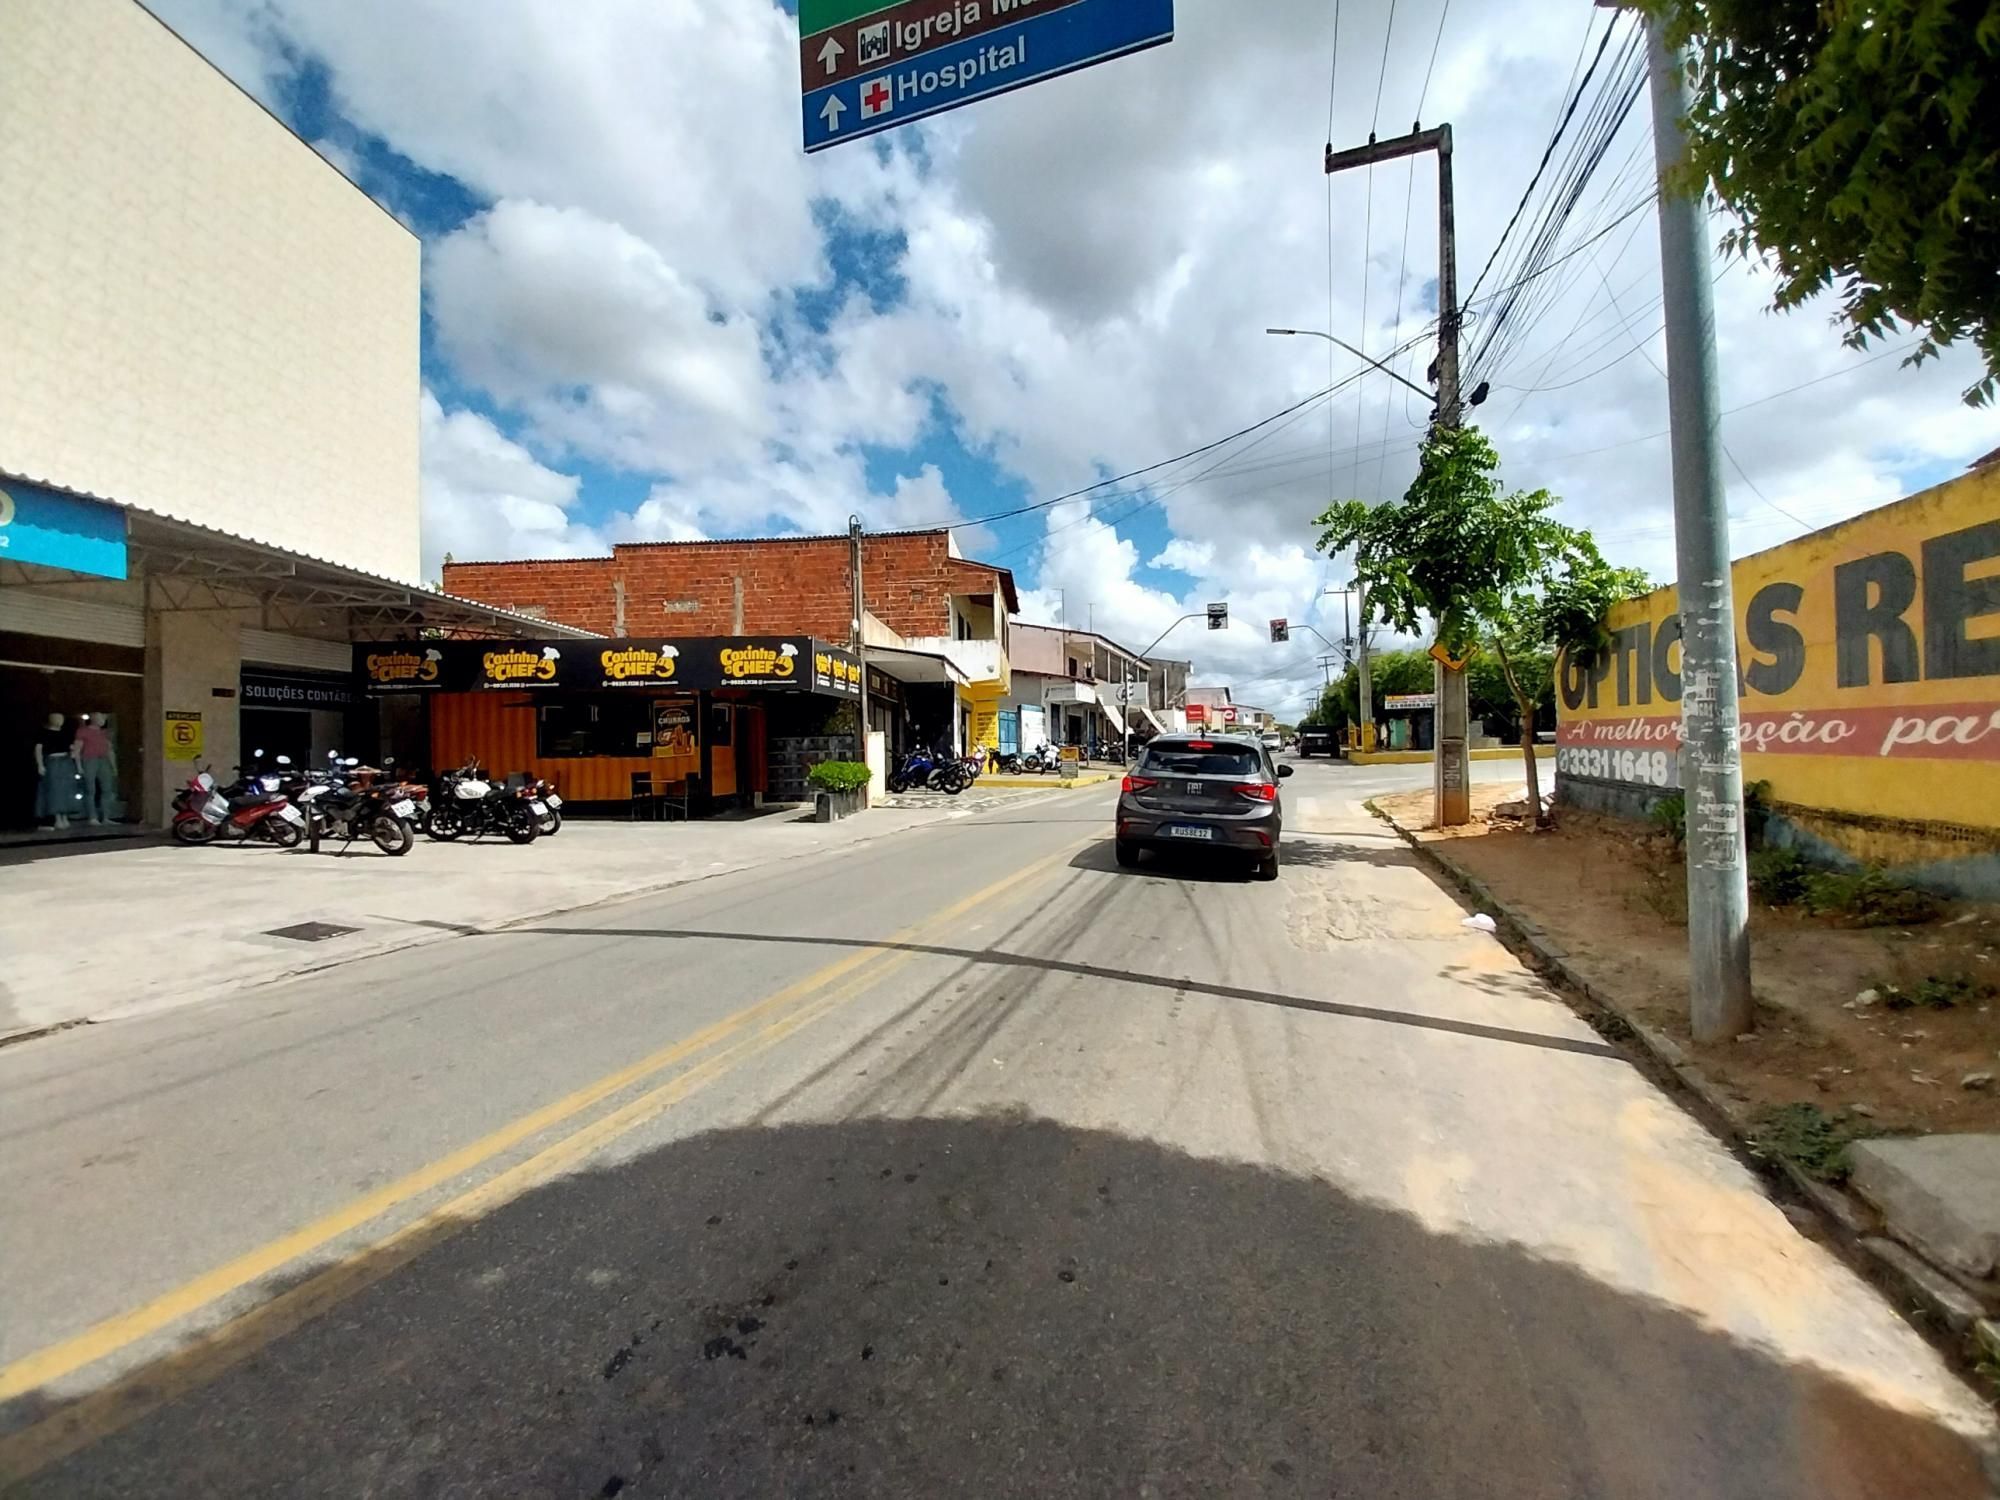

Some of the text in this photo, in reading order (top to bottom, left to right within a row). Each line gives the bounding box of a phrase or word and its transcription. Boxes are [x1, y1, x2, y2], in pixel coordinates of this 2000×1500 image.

[895, 1, 980, 50] Igreja
[898, 35, 1026, 101] Hospital
[1560, 519, 2000, 711] OPTICS RE
[483, 648, 539, 670] Coxinha
[601, 646, 657, 668] Coxinha
[720, 645, 777, 666] Coxinha
[494, 664, 536, 681] CHEF
[613, 662, 656, 679] CHEF
[732, 660, 775, 677] CHEF
[245, 684, 304, 701] SOLUÇÕES
[1567, 720, 1592, 740] A
